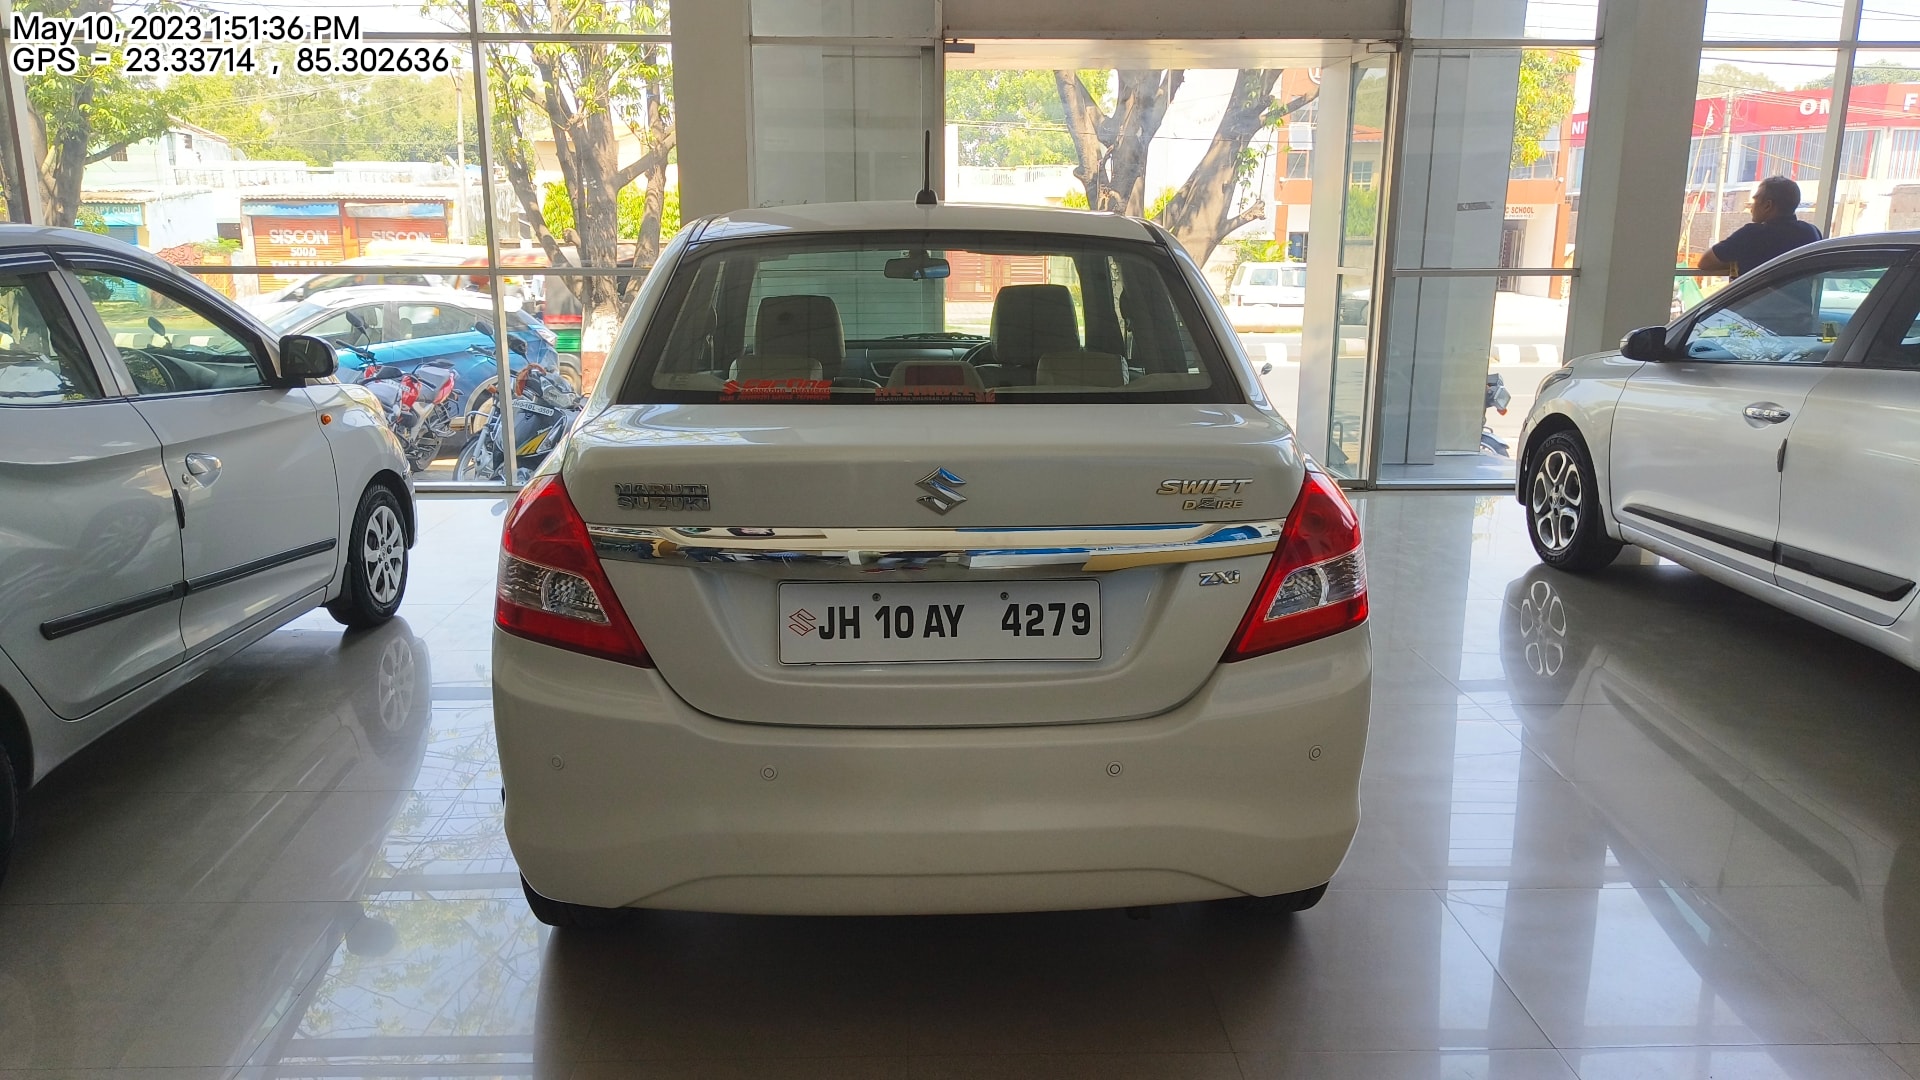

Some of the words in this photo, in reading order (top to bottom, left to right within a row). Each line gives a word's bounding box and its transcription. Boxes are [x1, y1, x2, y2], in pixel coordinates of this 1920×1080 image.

[1571, 121, 1588, 135] NI
[112, 206, 139, 214] CLINIC
[1511, 206, 1534, 214] SCHOOL
[269, 229, 329, 245] SISCON
[615, 483, 709, 495] MARUTI
[1156, 478, 1254, 495] SWIFT
[617, 496, 711, 511] SUZUKI
[818, 605, 861, 639] JH
[874, 605, 914, 638] 10
[922, 604, 965, 638] AY
[1001, 603, 1091, 637] 4279
